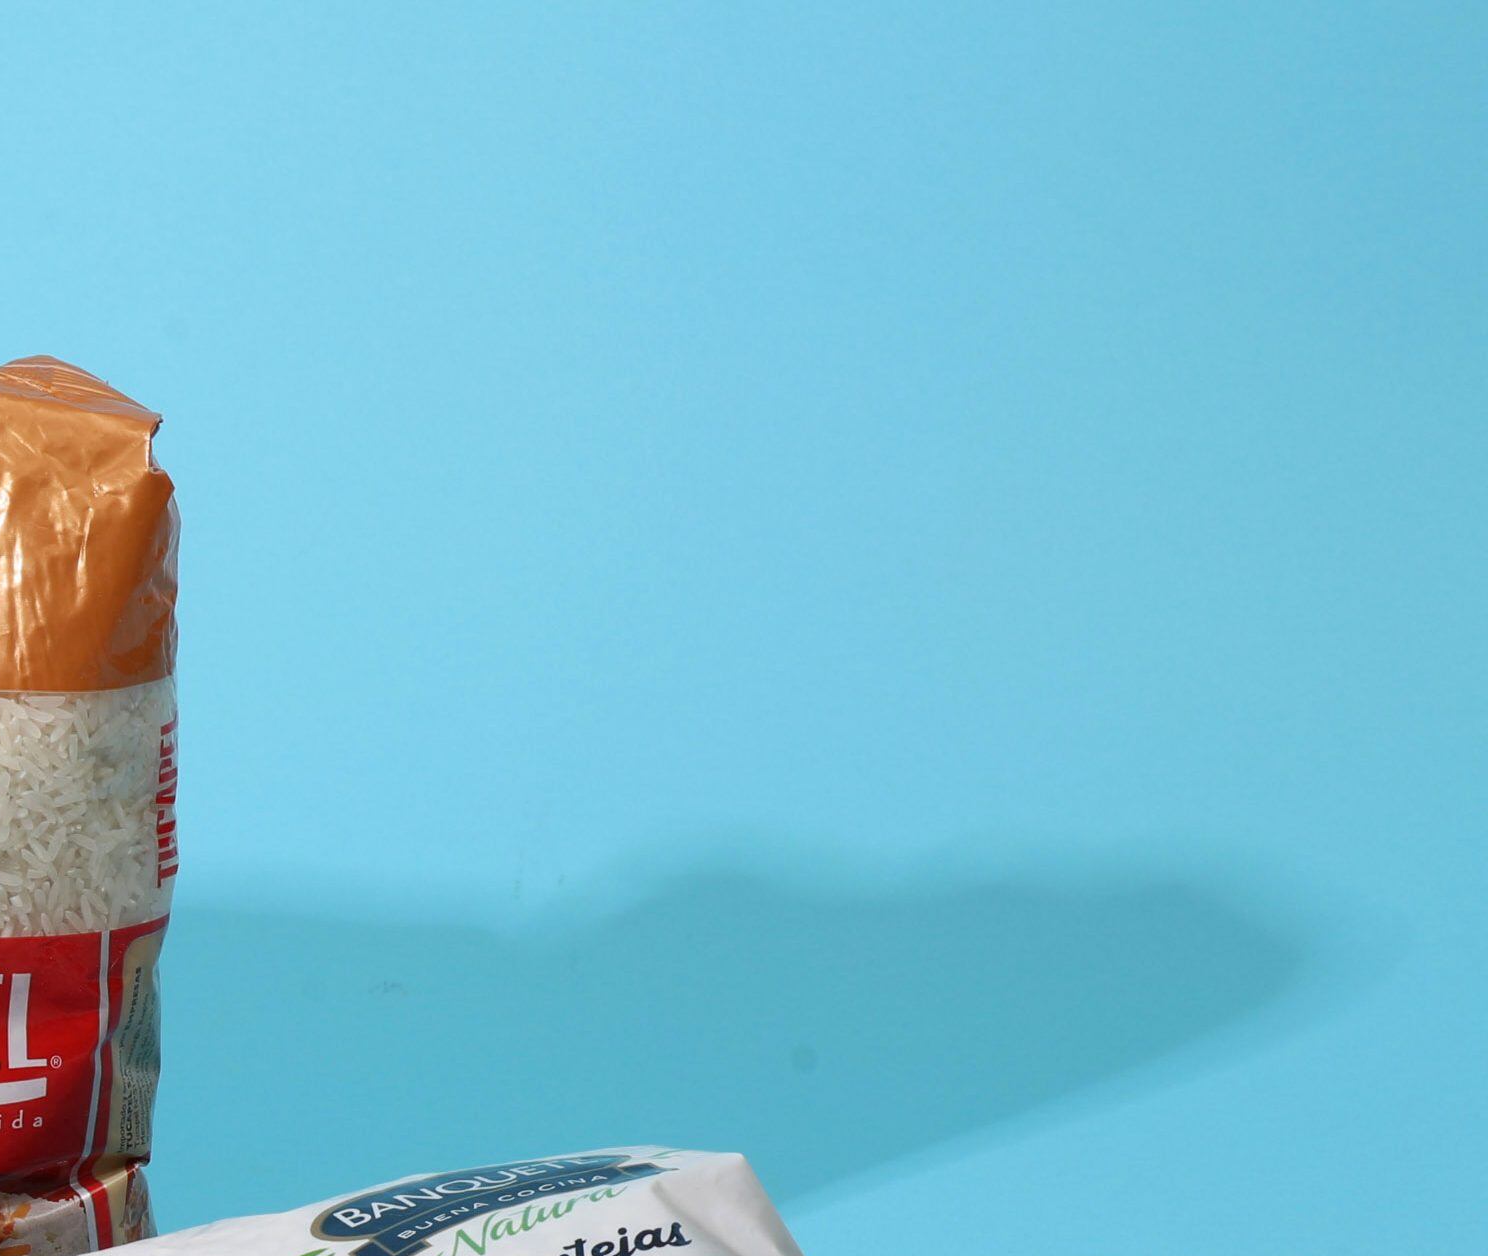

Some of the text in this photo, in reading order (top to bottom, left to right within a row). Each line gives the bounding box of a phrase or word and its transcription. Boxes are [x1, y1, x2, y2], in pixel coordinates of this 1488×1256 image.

[156, 721, 179, 887] TUCAPEL
[333, 1154, 604, 1229] BANQUETE
[398, 1174, 608, 1240] BUENA COCINA
